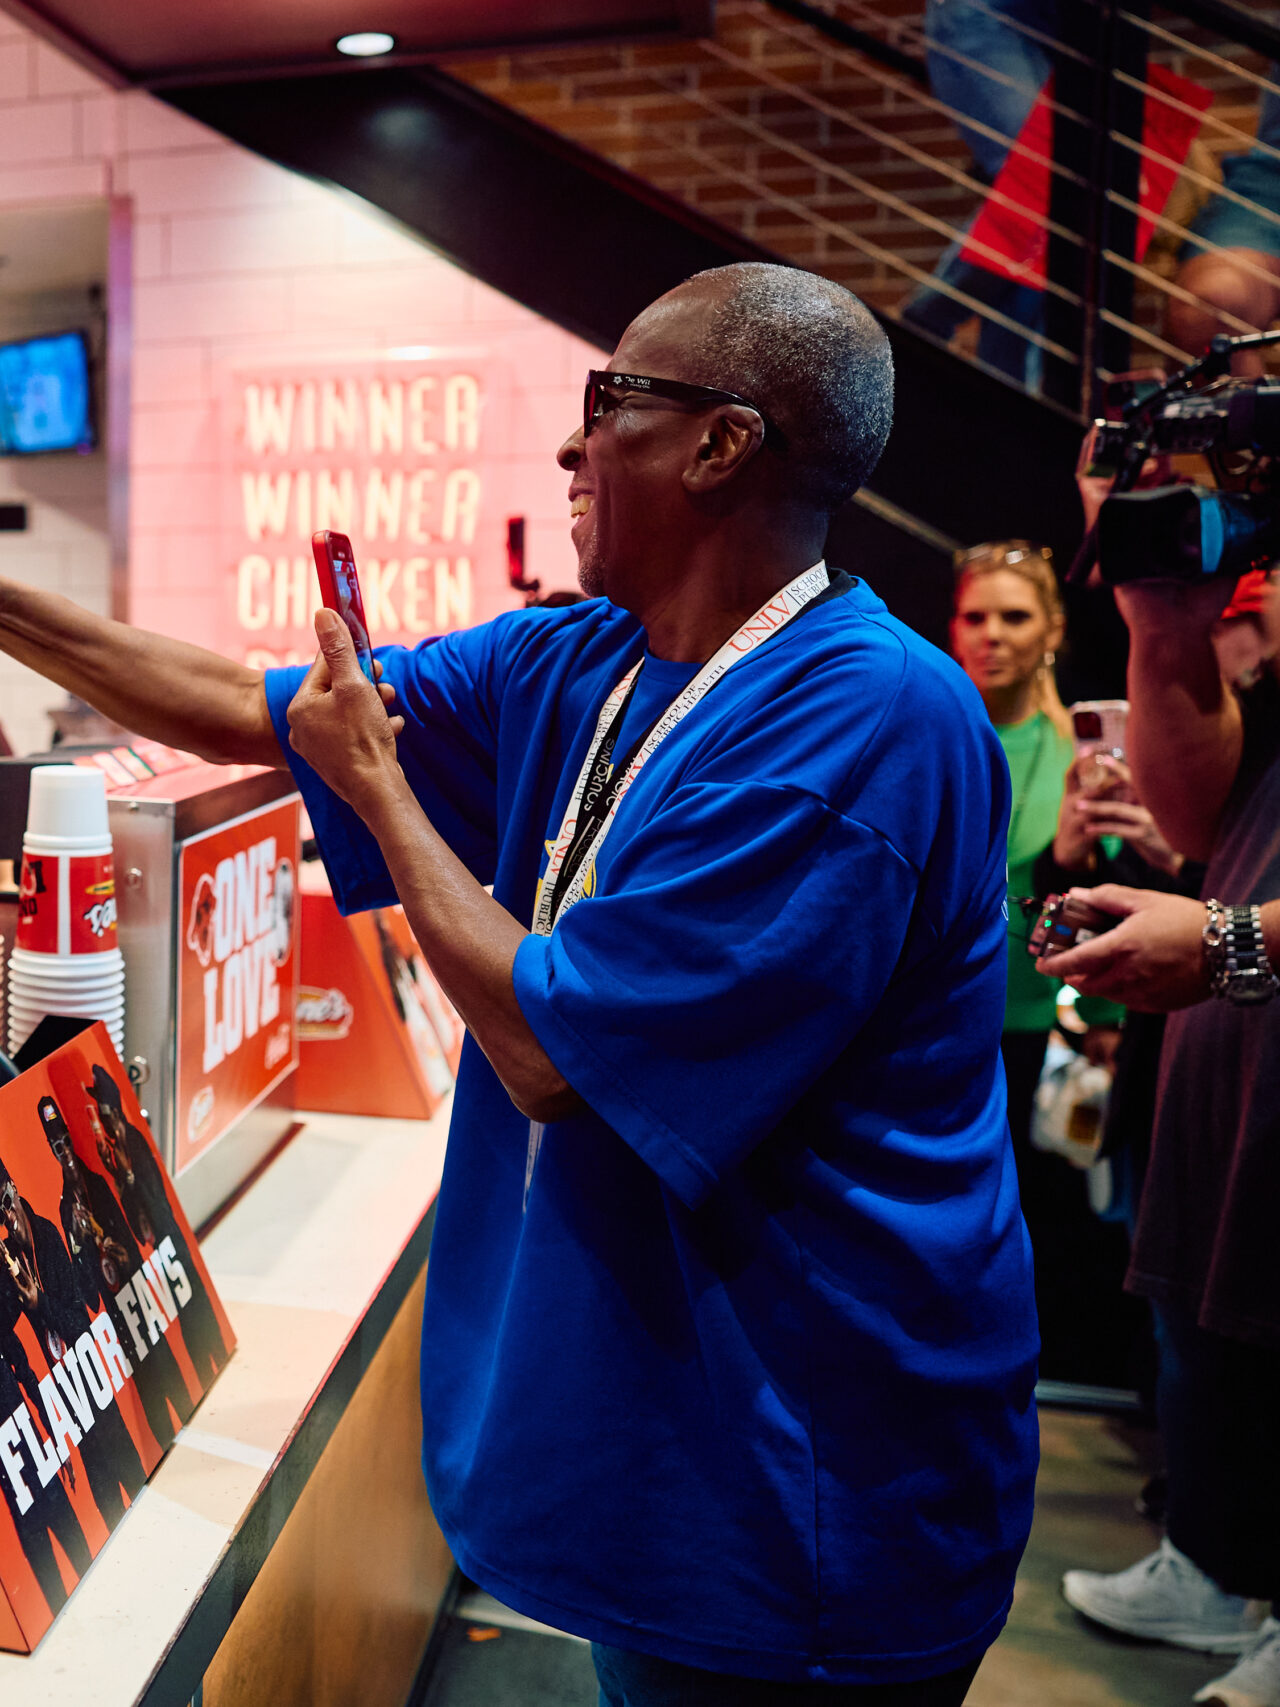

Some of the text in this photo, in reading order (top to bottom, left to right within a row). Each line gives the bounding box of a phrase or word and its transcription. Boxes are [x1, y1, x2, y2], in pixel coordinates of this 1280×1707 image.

[244, 374, 480, 455] WINNER
[241, 467, 481, 545] WINNER
[237, 553, 472, 633] CHIKEN
[728, 593, 791, 652] UNLV
[646, 682, 697, 749] SCHOOL OF
[682, 663, 725, 710] HEALTH
[583, 736, 616, 811] SOURCING
[213, 837, 277, 963] ONE
[534, 886, 554, 930] PUBLIC
[202, 936, 281, 1074] LOVE
[114, 1235, 193, 1362] FAVS
